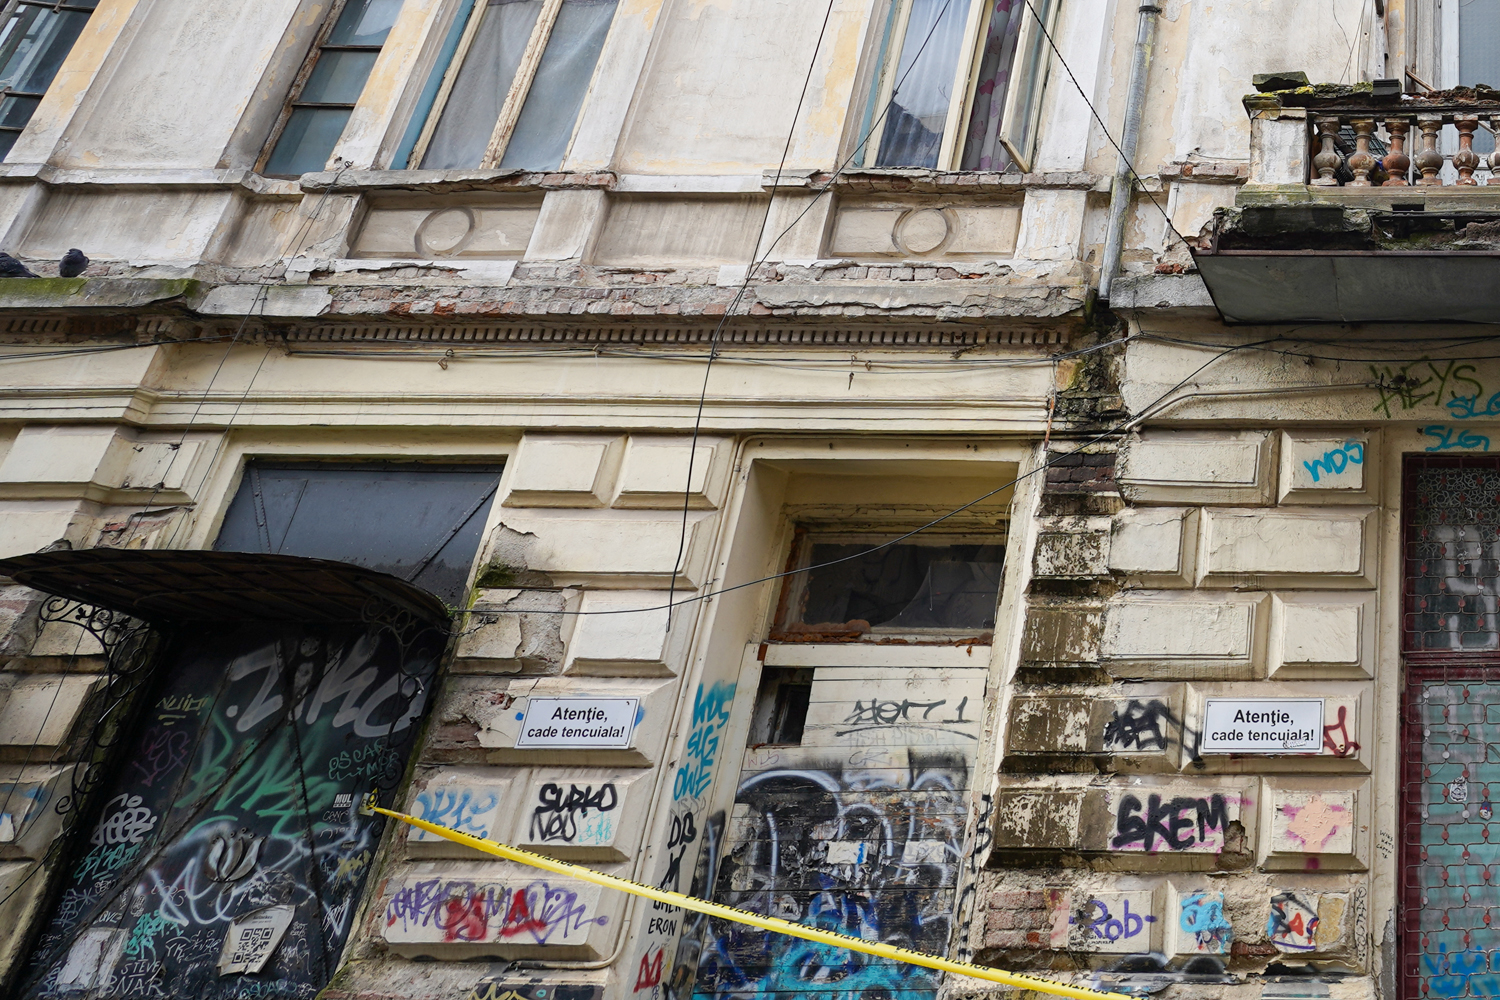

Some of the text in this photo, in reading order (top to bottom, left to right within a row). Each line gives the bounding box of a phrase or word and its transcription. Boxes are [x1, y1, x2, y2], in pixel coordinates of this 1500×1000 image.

[527, 726, 625, 738] cade tencuiala!
[1211, 729, 1314, 742] cade tencuiala!
